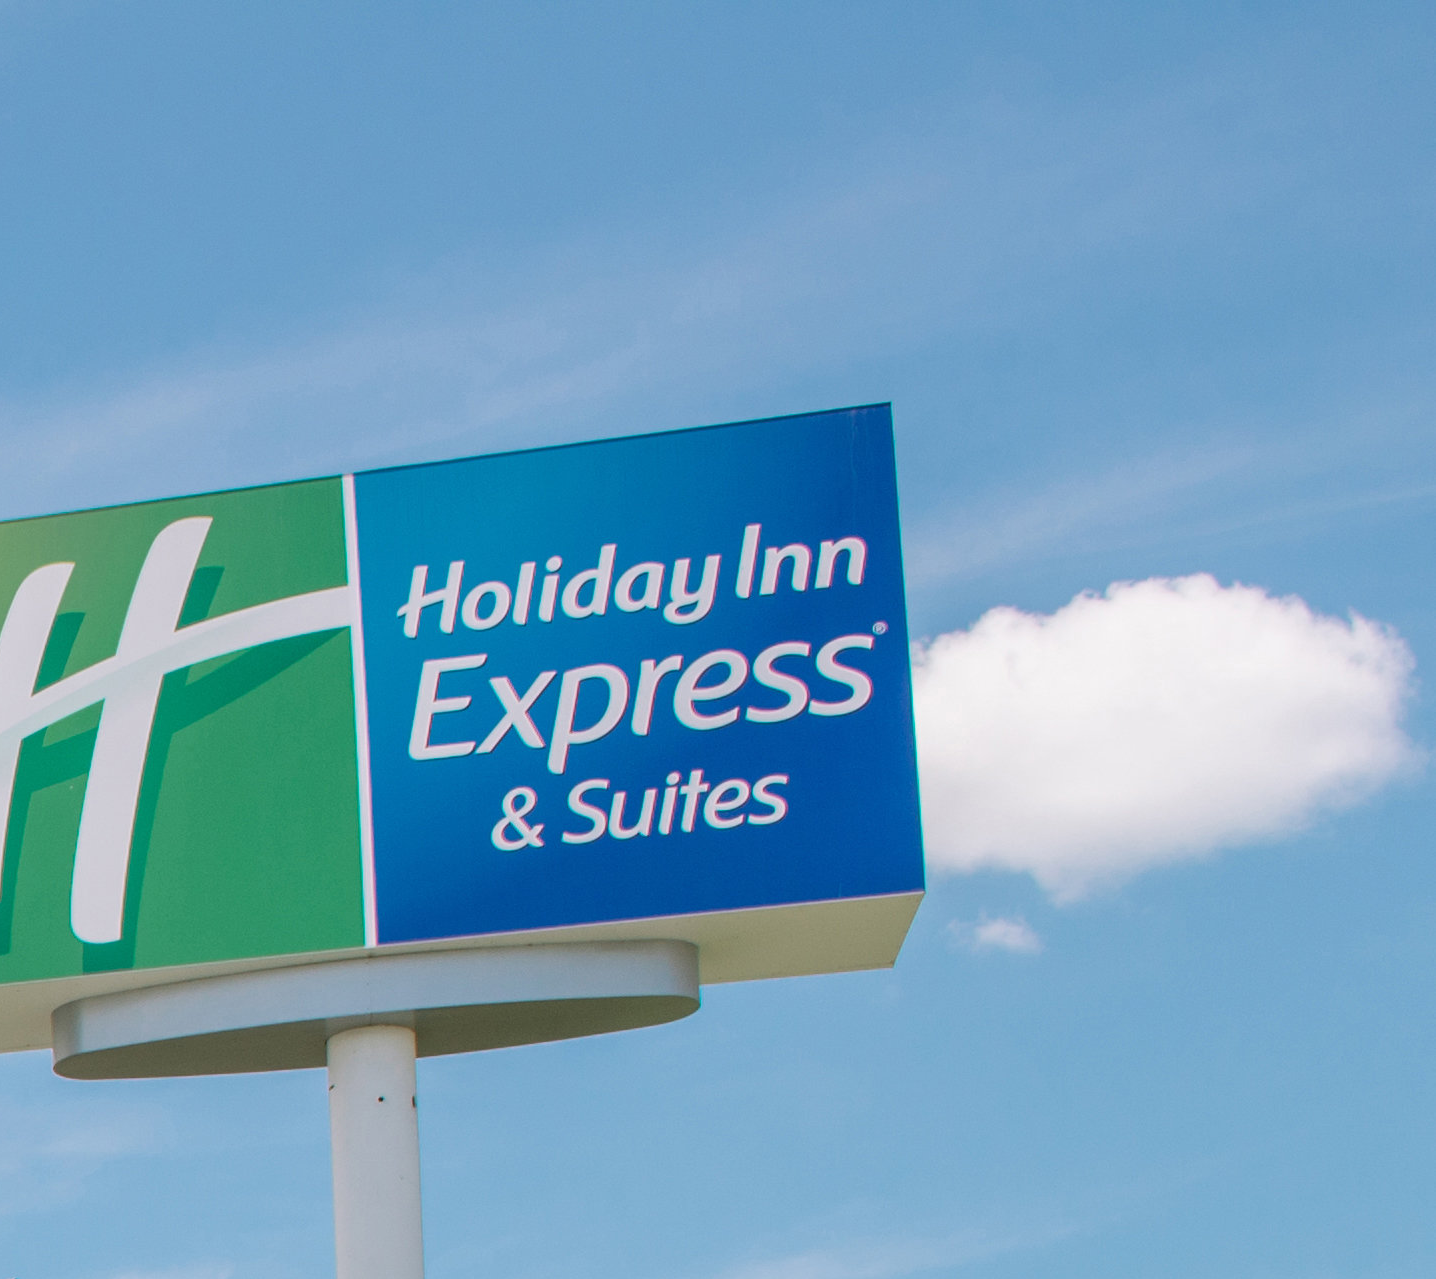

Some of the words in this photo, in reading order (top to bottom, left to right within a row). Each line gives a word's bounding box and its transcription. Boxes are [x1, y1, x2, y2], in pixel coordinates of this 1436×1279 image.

[396, 543, 721, 639] Holiday
[735, 523, 867, 599] Inn
[491, 786, 544, 851] &
[561, 769, 789, 844] Suites
